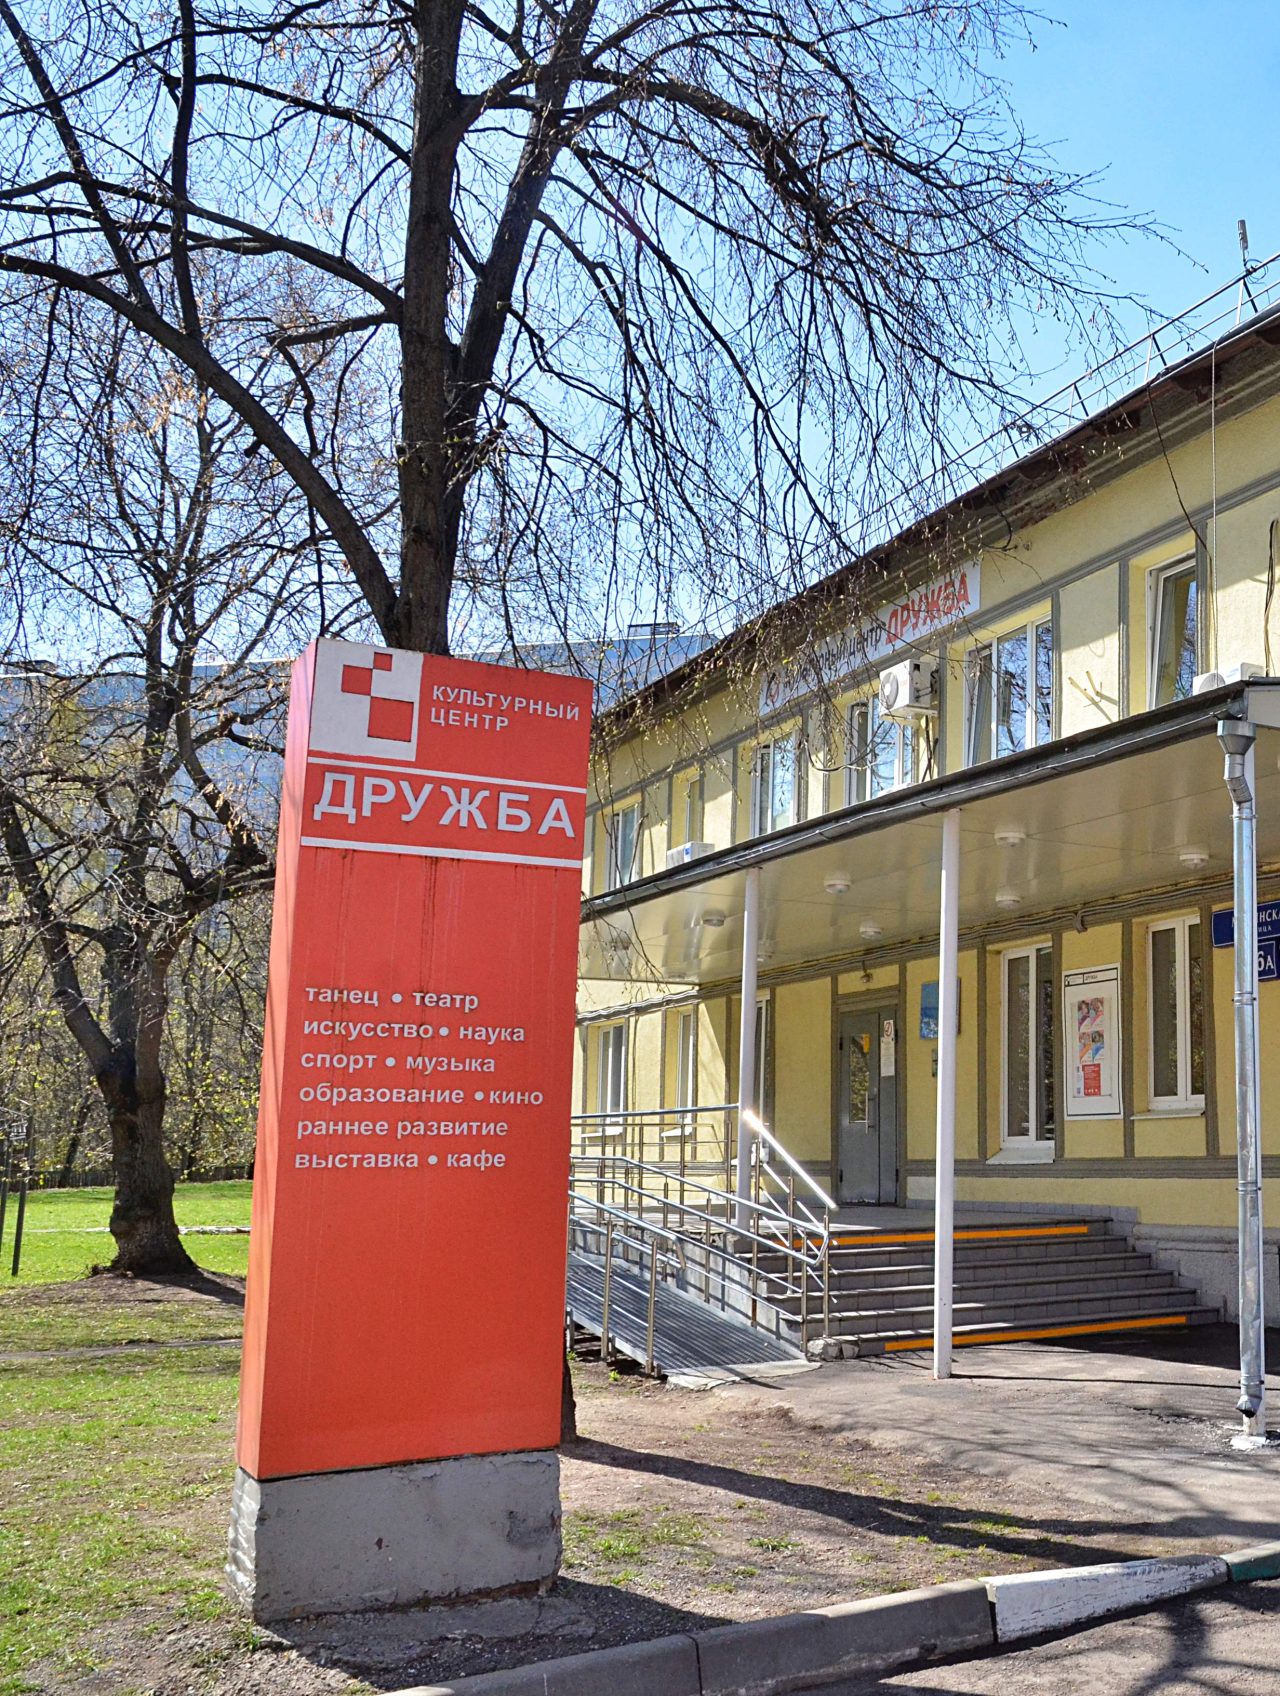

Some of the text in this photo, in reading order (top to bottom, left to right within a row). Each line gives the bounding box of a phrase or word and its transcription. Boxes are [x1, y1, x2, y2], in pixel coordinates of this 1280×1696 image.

[885, 572, 970, 645] ДРУЖБА
[432, 685, 580, 721] КУЛЬТУРНЫЙ
[430, 707, 509, 731] ЦЕНТР
[313, 771, 575, 838] ДРУЖБА
[305, 987, 479, 1012] танец театр
[303, 1020, 525, 1045] искусство наука
[301, 1052, 495, 1075] спорт музыка
[299, 1082, 544, 1106] образование кино
[297, 1120, 508, 1139] раннее развитие
[295, 1149, 506, 1171] выставка кафе
